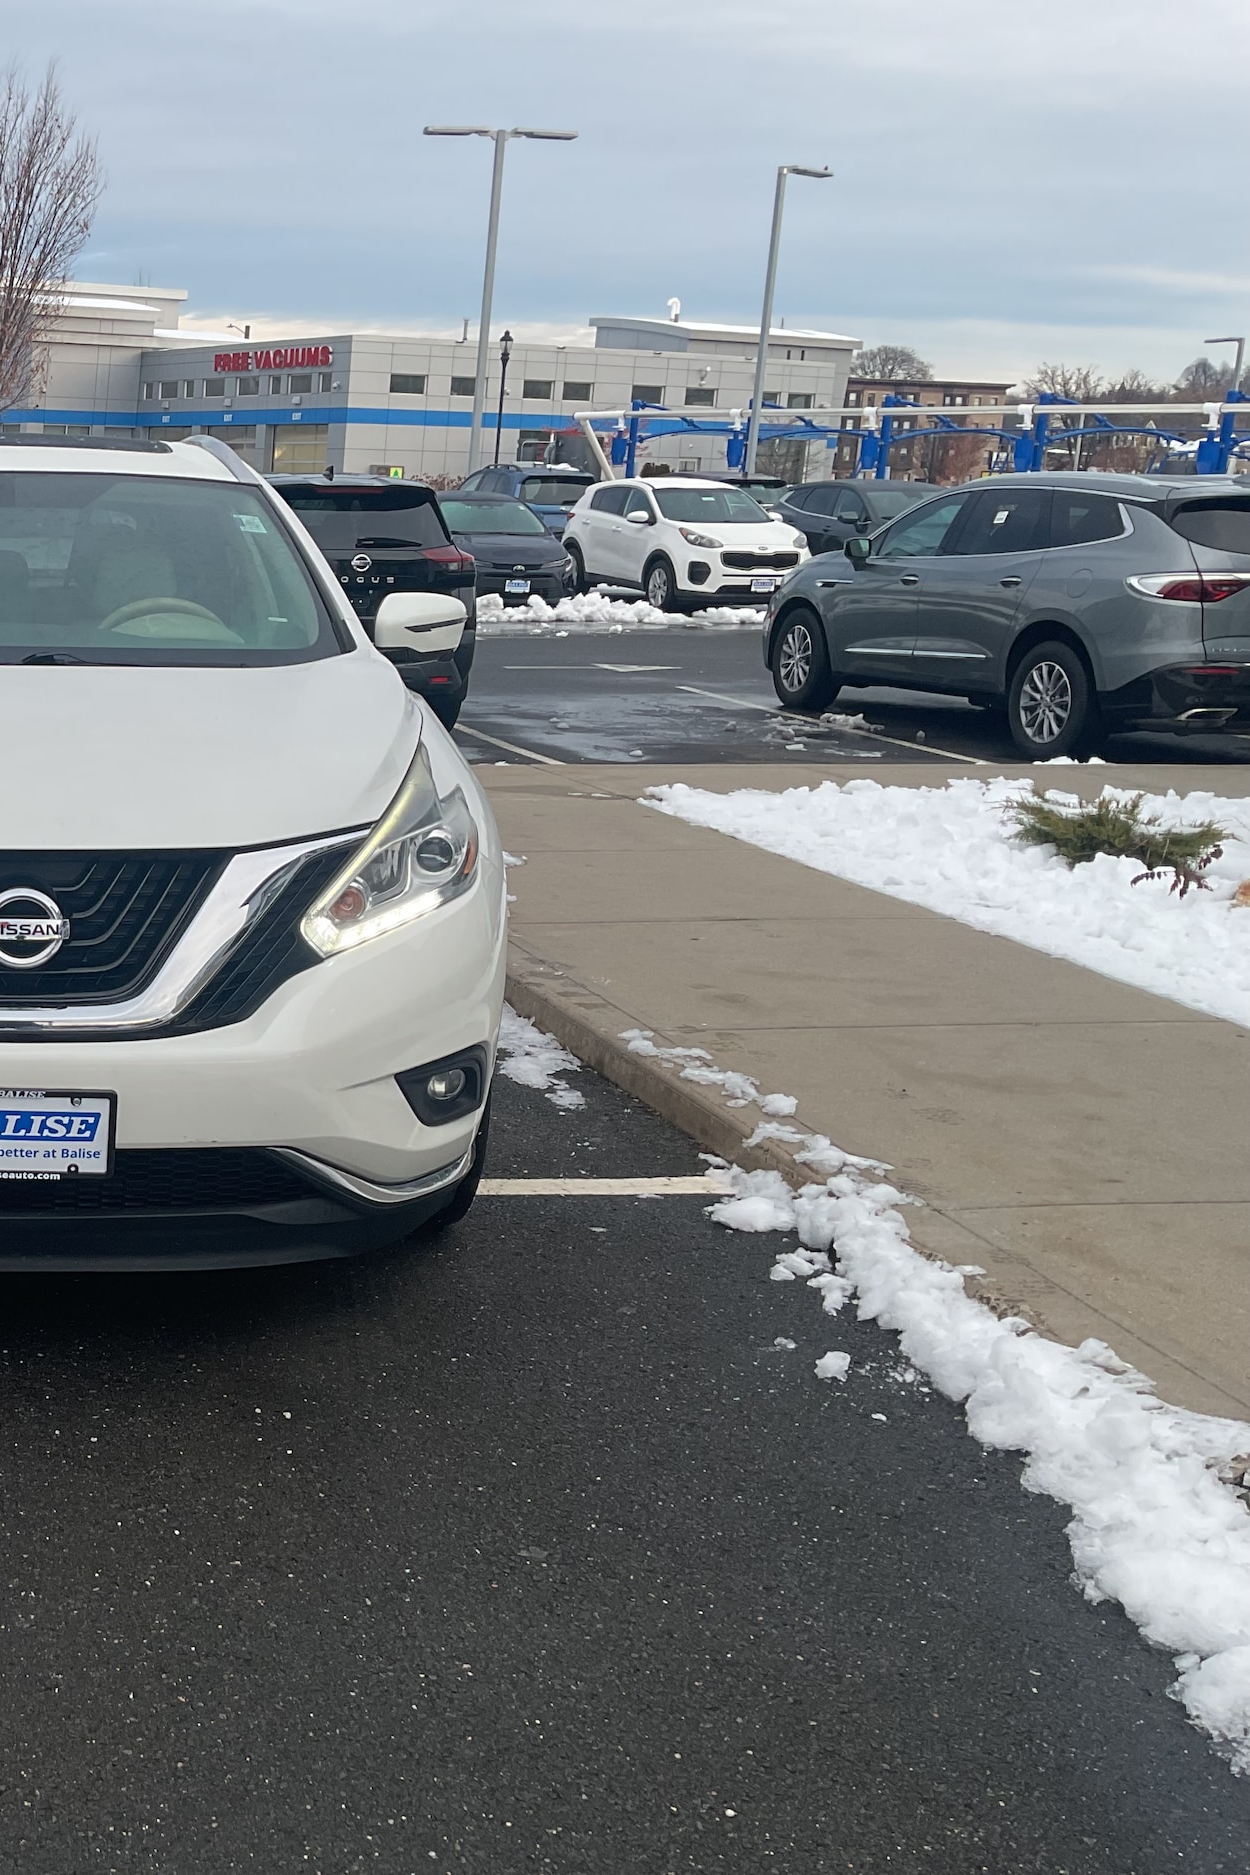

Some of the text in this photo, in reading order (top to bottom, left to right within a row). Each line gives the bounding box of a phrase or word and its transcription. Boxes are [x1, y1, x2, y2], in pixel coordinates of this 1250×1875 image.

[214, 345, 333, 373] FREE VACUUMS
[340, 576, 395, 584] OGUE
[43, 1148, 57, 1159] at
[61, 1148, 101, 1160] Balise
